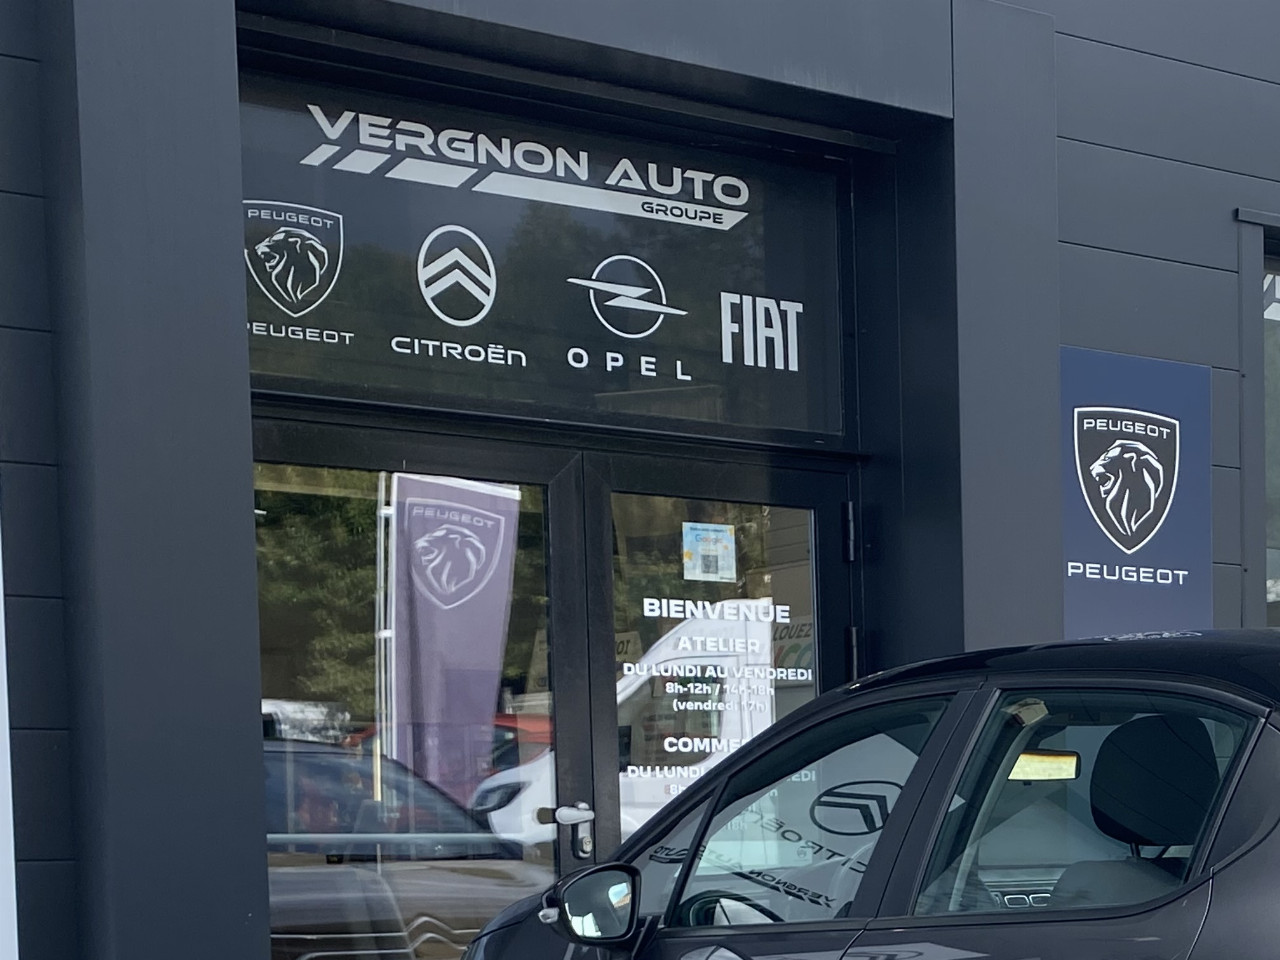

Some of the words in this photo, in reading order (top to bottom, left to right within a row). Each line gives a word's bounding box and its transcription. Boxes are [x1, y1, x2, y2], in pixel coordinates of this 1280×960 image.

[306, 104, 589, 182] VERGNON
[604, 157, 750, 206] AUTO
[247, 208, 334, 229] PEUGEOT
[640, 201, 725, 225] GROUPE
[247, 321, 355, 345] EUGEOT
[720, 291, 803, 372] FIAT
[567, 346, 692, 381] OPEL
[1083, 418, 1171, 440] PEUGEOT
[412, 505, 497, 529] PEUGEOT
[1067, 561, 1189, 586] PEUGEOT
[643, 598, 791, 624] BIENVENUE
[678, 636, 760, 653] ATELIER
[623, 663, 647, 676] DU
[651, 664, 701, 678] LUNDI
[704, 665, 729, 678] AU
[733, 666, 813, 681] VENDREDI
[665, 682, 711, 695] 8h-12h
[672, 699, 738, 712] (vendredi
[627, 765, 651, 778] DU
